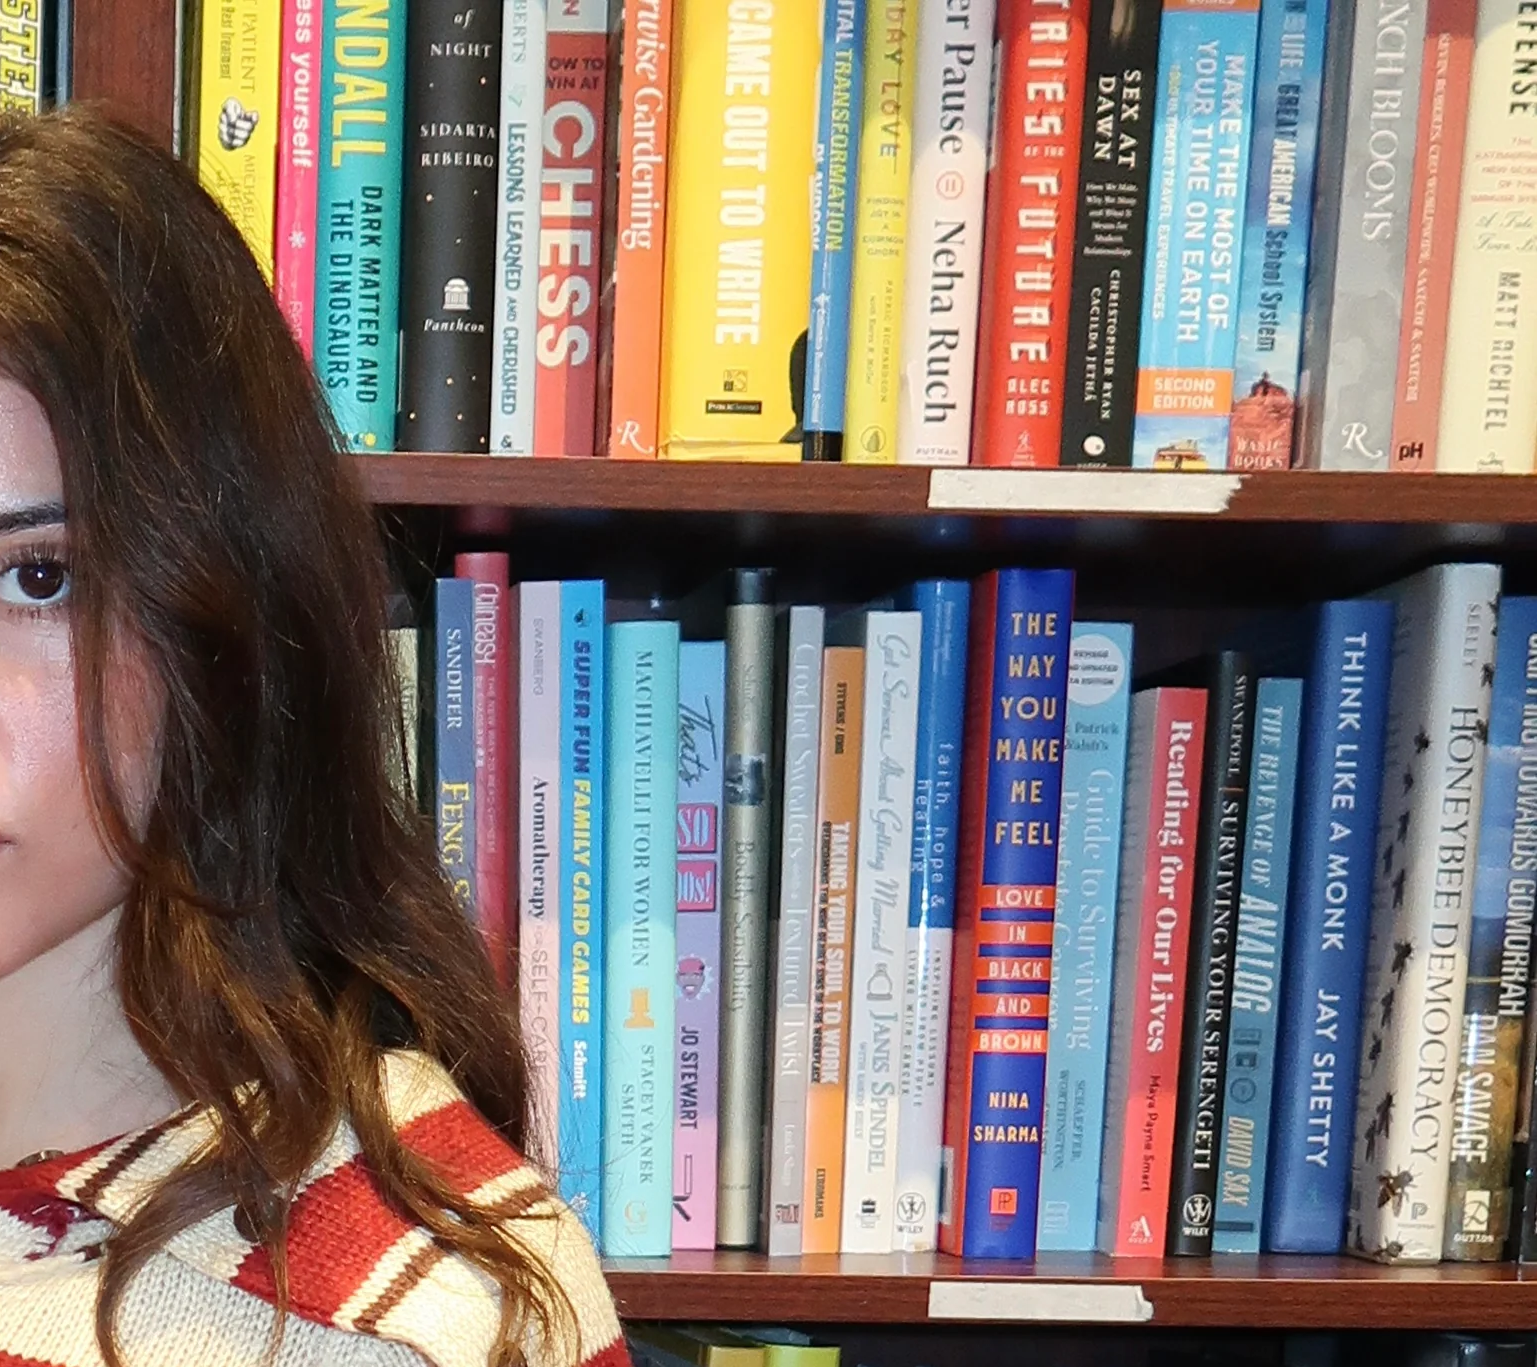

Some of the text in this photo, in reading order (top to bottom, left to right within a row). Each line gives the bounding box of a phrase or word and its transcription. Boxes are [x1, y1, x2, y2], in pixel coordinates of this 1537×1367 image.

[430, 43, 493, 59] NIGHT
[1094, 75, 1117, 161] DAWN
[1117, 69, 1142, 171] SEX AT
[420, 123, 496, 140] SIDARTA
[722, 105, 770, 171] OUT
[421, 152, 494, 168] RIBEIRO
[620, 87, 663, 250] Gardening
[1176, 39, 1220, 343] YOUR TIME ON EARTH
[1207, 55, 1246, 331] MAKE THE MOST OF
[719, 184, 765, 227] TO
[535, 100, 595, 369] CHESS
[327, 200, 354, 390] THE DINOSAURS
[356, 187, 383, 403] DARK MATTER AND
[715, 238, 765, 346] WRITE
[423, 318, 485, 334] Pantheon
[923, 220, 966, 425] Neha Ruch
[1007, 377, 1051, 394] ALEC
[1153, 376, 1217, 393] SECOND
[1006, 399, 1049, 416] ROSS
[1152, 394, 1215, 411] EDITION
[1012, 612, 1058, 637] THE
[1008, 654, 1055, 679] WAY
[1001, 696, 1058, 721] YOU
[996, 738, 1061, 764] MAKE
[1010, 780, 1044, 804] ME
[1322, 631, 1369, 952] THINK LIKE A MONK
[570, 640, 592, 1023] SUPER FUN FAMILY CARD GAMES
[994, 821, 1055, 846] FEEL
[995, 889, 1044, 908] LOVE
[1145, 721, 1193, 1053] Reading for Our Lives
[1008, 924, 1027, 944] IN
[1410, 706, 1479, 1163] HONEYBEE DEMOCRACY
[988, 960, 1044, 980] BLACK
[995, 996, 1033, 1016] AND
[978, 1032, 1043, 1052] BROWN
[1306, 988, 1340, 1168] JAY SHETTY
[988, 1091, 1030, 1110] NINA
[973, 1124, 1040, 1145] SHARMA
